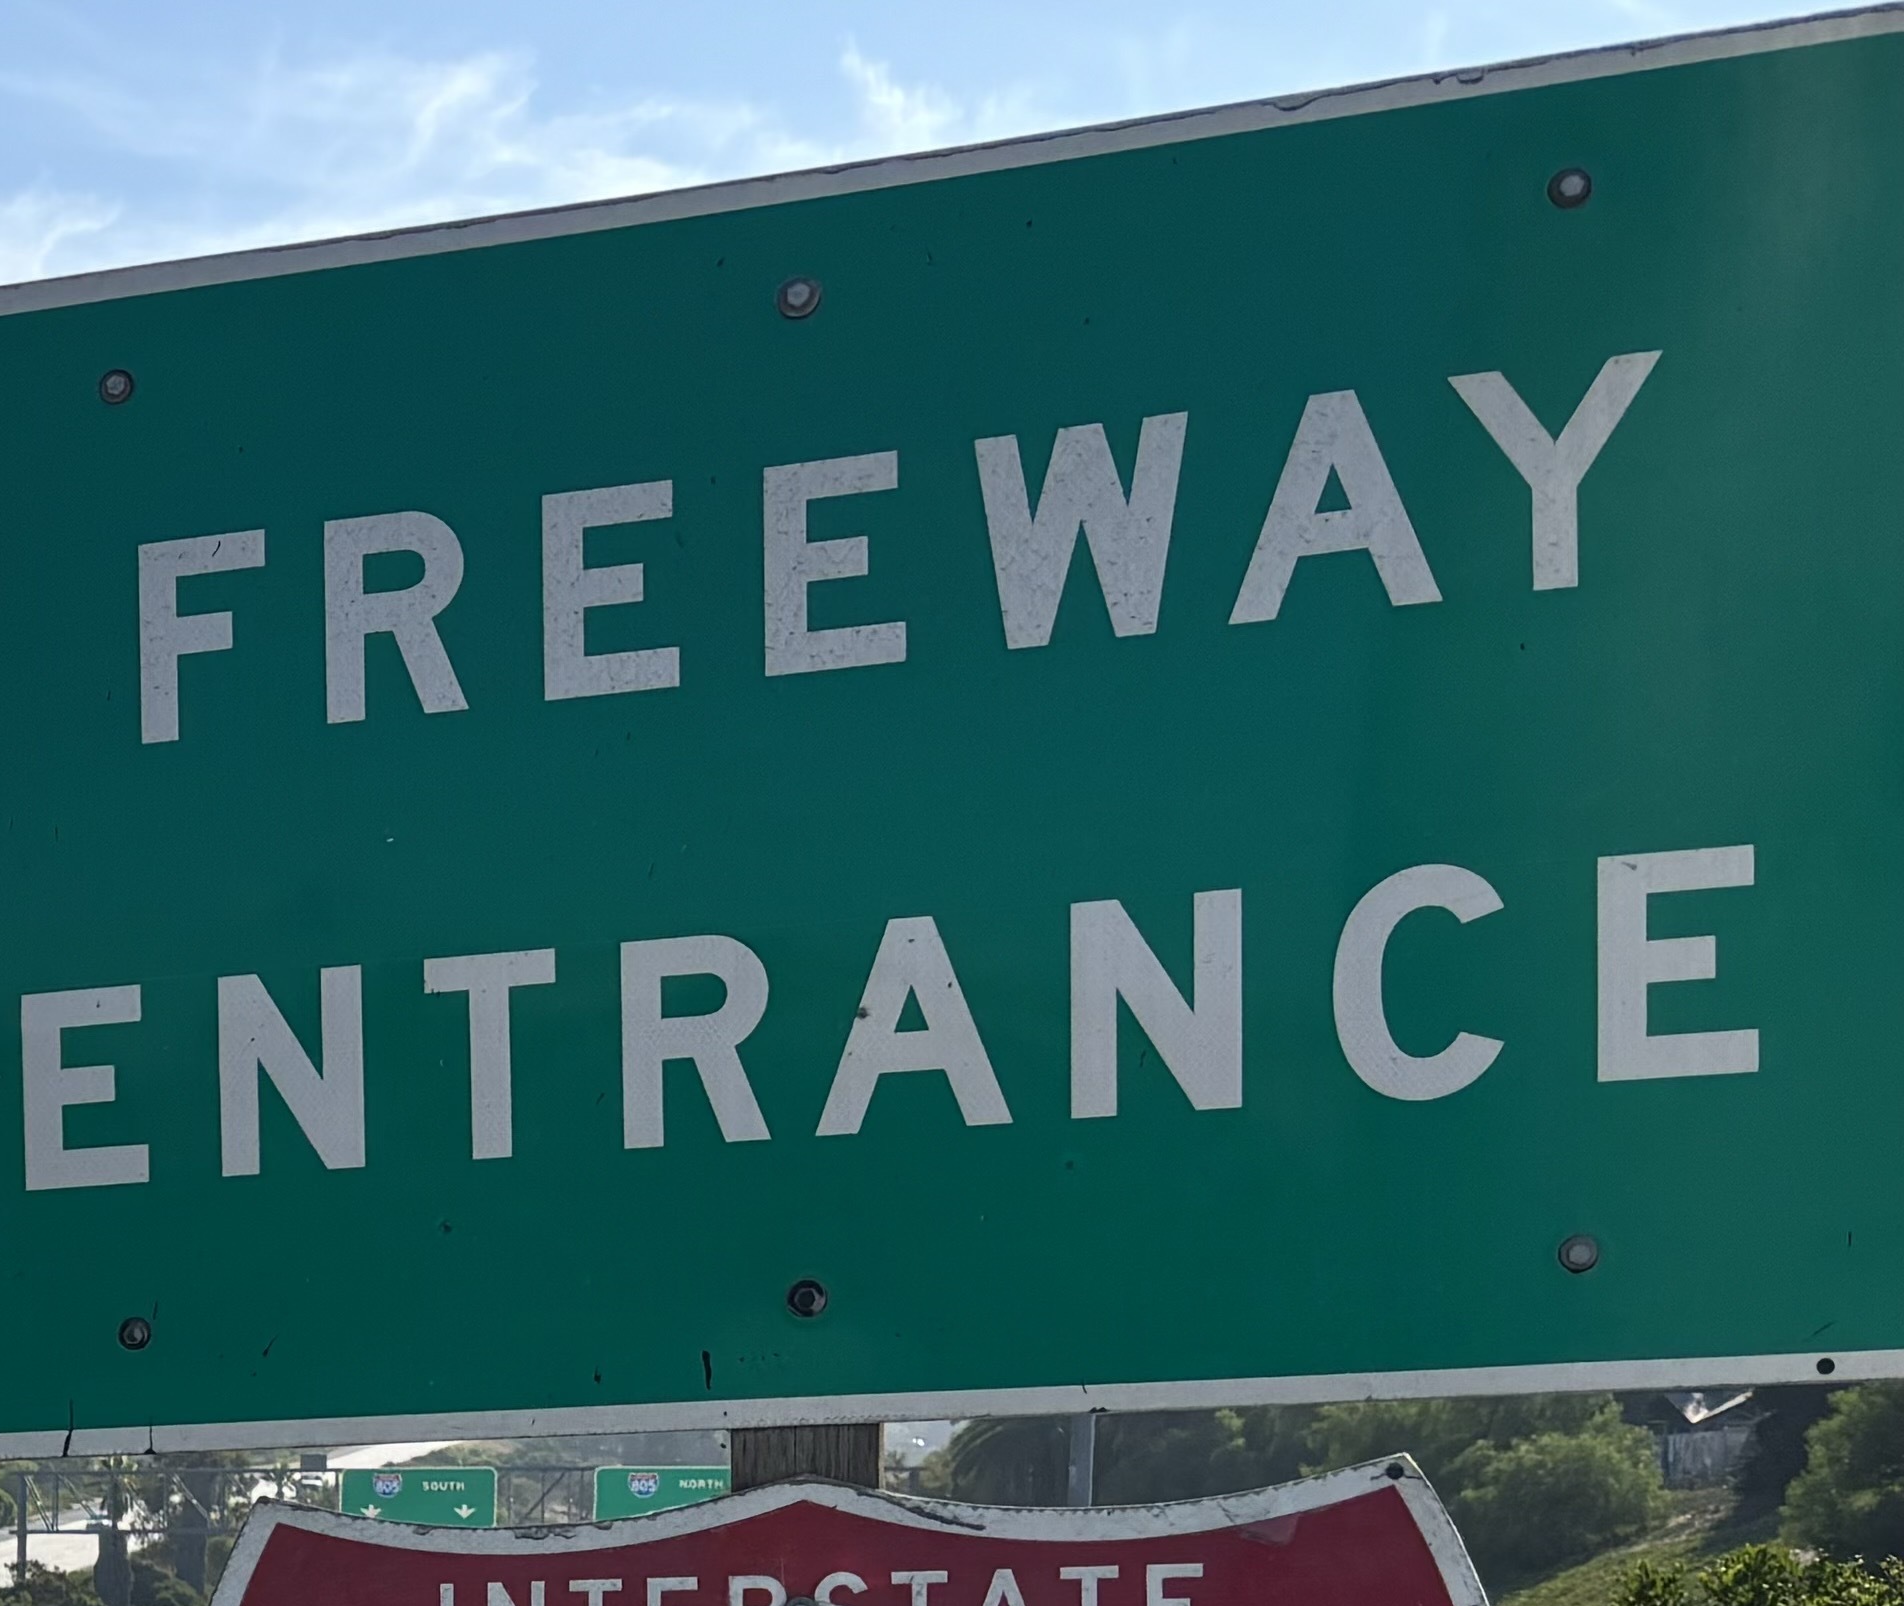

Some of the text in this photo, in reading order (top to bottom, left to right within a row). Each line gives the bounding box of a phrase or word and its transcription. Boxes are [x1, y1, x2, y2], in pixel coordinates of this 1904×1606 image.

[139, 351, 1662, 743] FREEWAY
[22, 845, 1759, 1190] ENTRANCE
[376, 1480, 465, 1494] 805 SOUTH
[631, 1479, 723, 1493] 805 NORTH
